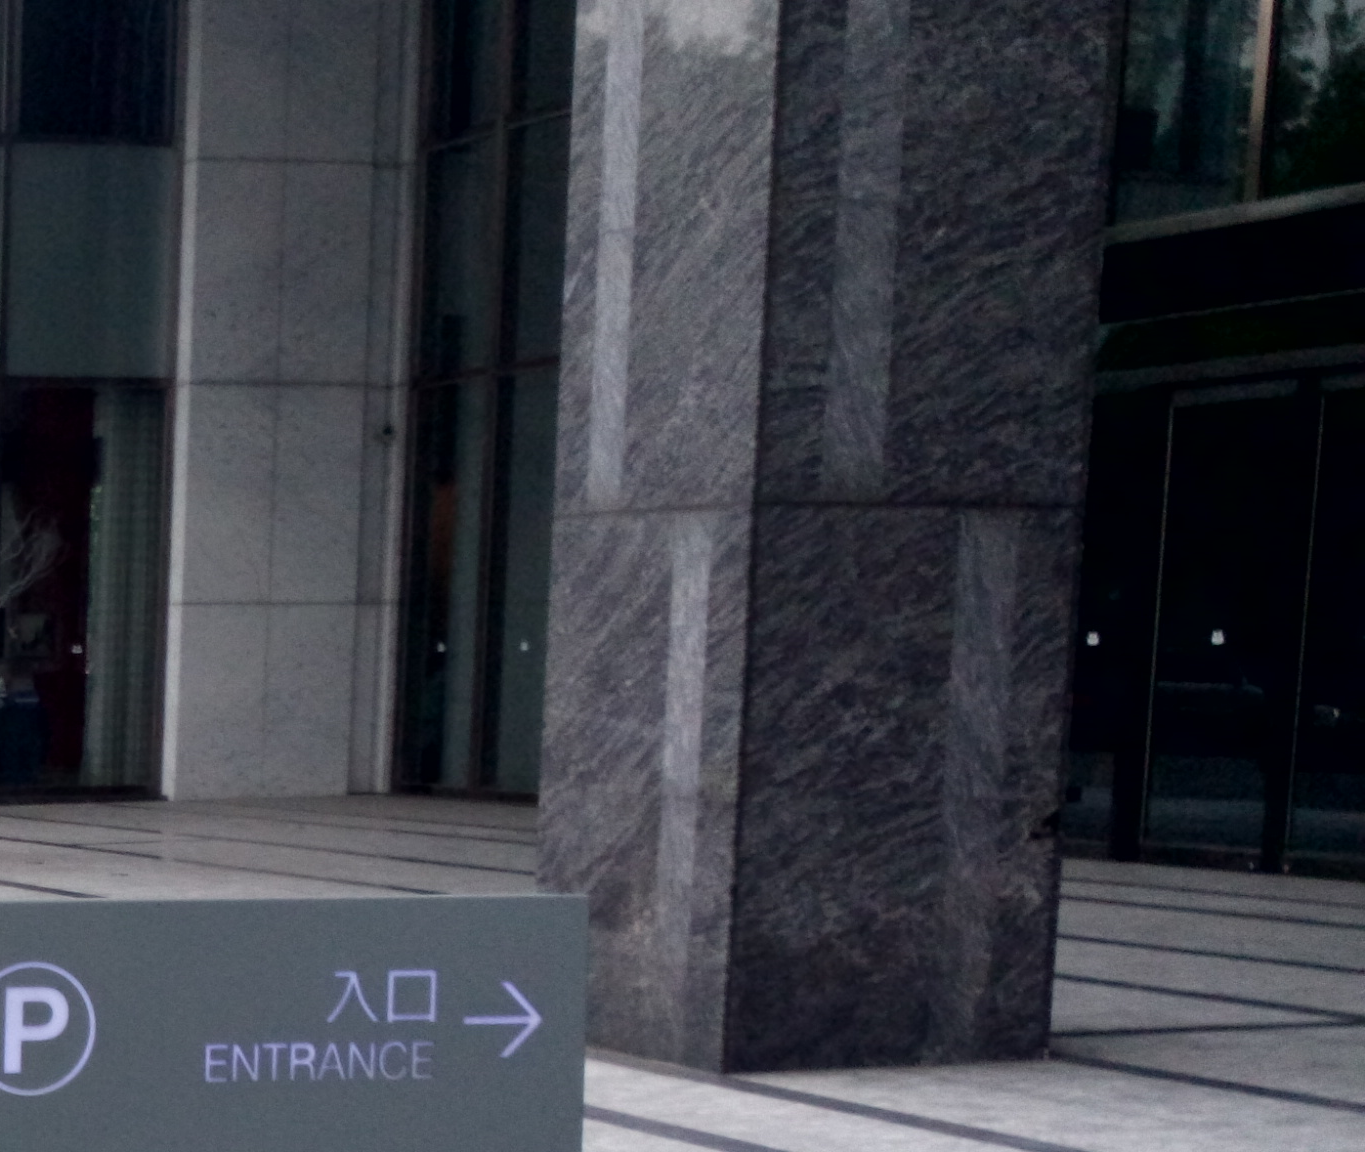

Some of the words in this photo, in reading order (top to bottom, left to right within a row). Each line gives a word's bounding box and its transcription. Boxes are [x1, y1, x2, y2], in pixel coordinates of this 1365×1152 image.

[327, 969, 437, 1023] 入口
[3, 986, 70, 1074] P
[205, 1041, 435, 1083] ENTRANCE
